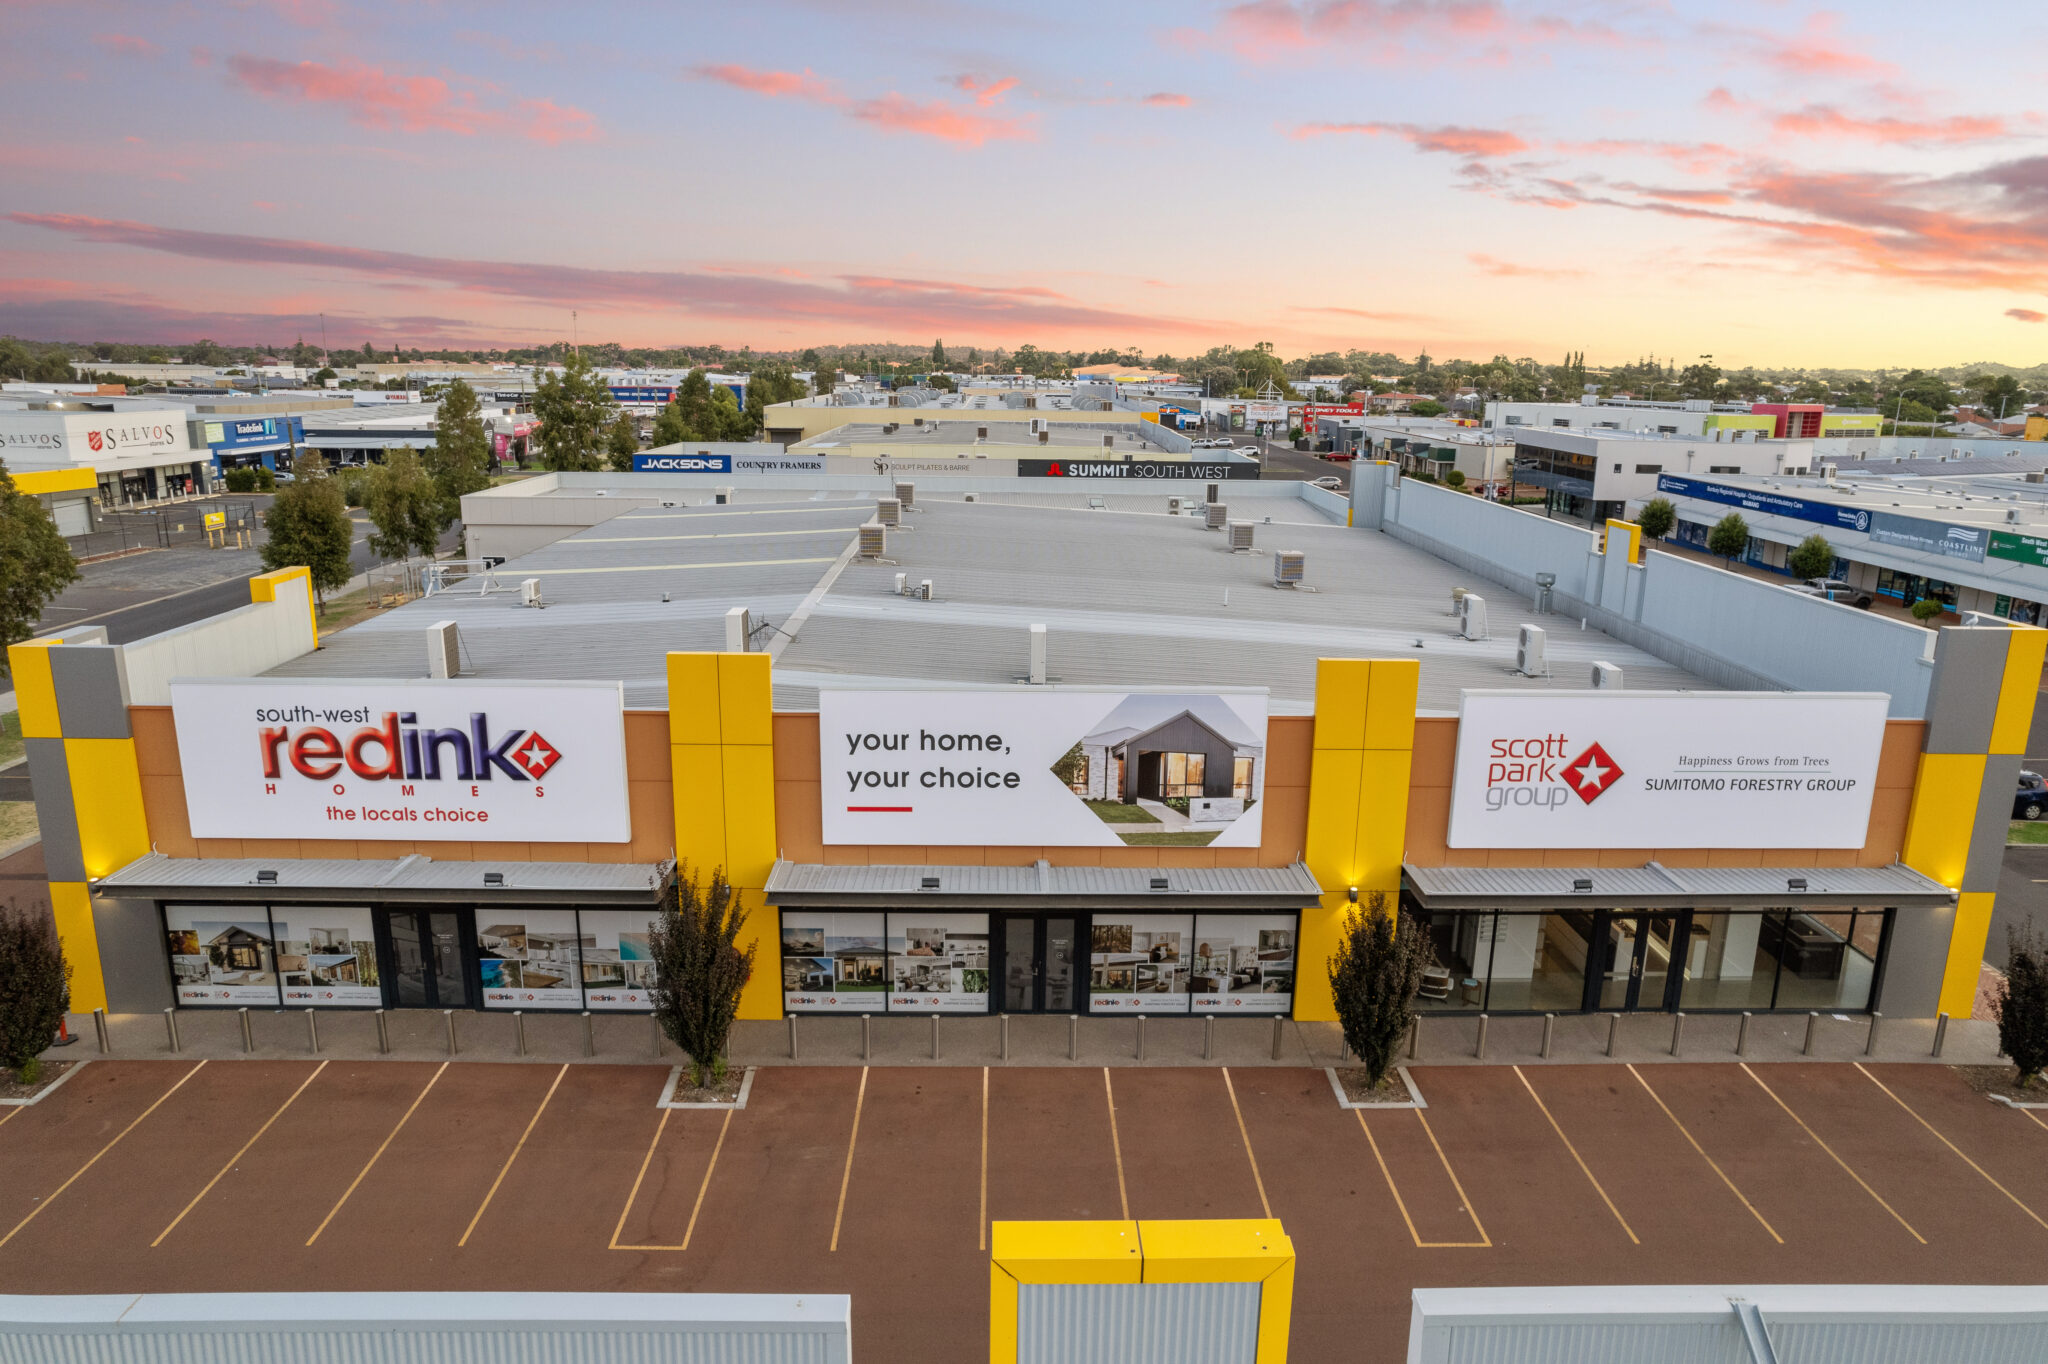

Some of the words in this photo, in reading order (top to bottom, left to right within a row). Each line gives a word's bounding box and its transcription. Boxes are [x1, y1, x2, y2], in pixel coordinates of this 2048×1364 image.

[106, 424, 174, 450] SALVOS
[236, 423, 263, 434] Tradelink
[641, 459, 722, 469] JACKSONS
[737, 461, 777, 469] COUNTRY
[1069, 464, 1129, 477] SUMMIT
[1134, 465, 1185, 478] SOUTH
[1190, 466, 1231, 479] WEST
[1938, 539, 1984, 554] COASTLINE
[256, 705, 370, 723] south-west
[846, 731, 909, 755] your
[919, 729, 1012, 755] home,
[1490, 733, 1568, 759] scott
[1678, 755, 1733, 768] Happiness
[1736, 756, 1770, 767] Grows
[1774, 755, 1799, 767] from
[1803, 756, 1830, 767] Trees
[847, 769, 910, 792] your
[919, 766, 1021, 789] choice
[1487, 759, 1556, 787] park
[1645, 778, 1725, 791] SUMITOMO
[1730, 779, 1802, 792] FORESTRY
[1807, 780, 1857, 792] GROUP
[1486, 787, 1569, 812] group
[326, 805, 356, 821] the
[362, 806, 418, 822] locals
[423, 807, 489, 822] choice
